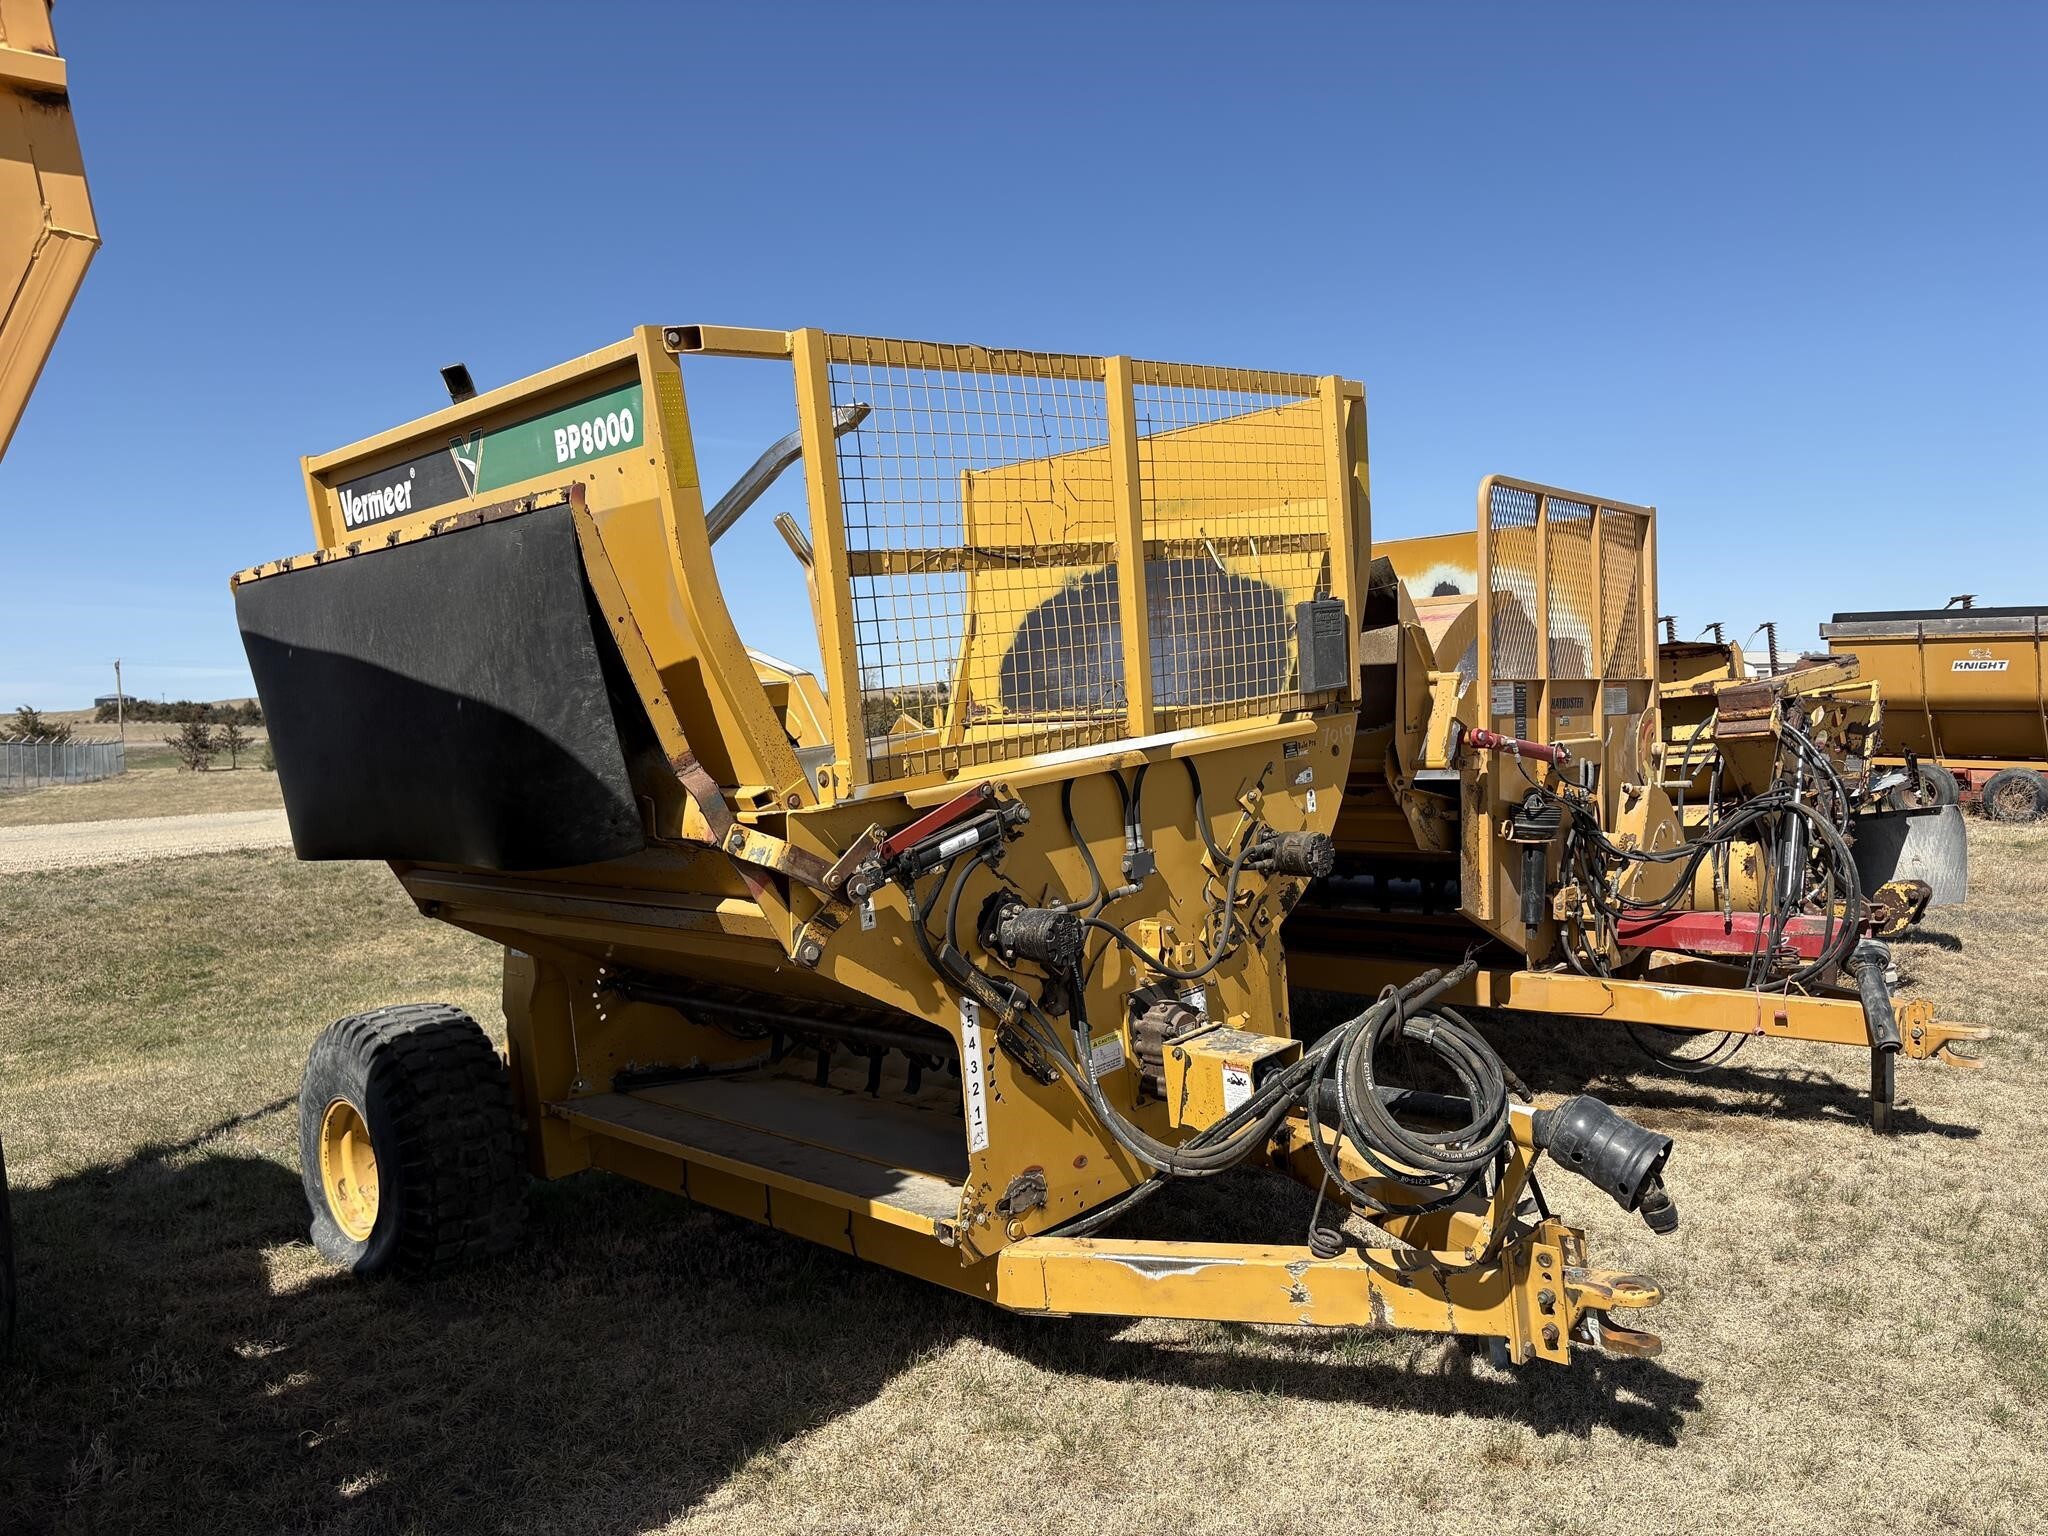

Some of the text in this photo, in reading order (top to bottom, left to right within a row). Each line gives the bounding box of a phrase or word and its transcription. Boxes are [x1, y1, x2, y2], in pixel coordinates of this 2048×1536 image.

[554, 408, 634, 463] BP8000
[1551, 697, 1584, 709] HAYBUSTER
[967, 1015, 974, 1028] 5
[969, 1036, 976, 1050] 4
[1098, 1034, 1119, 1045] CAUTION
[971, 1061, 978, 1074] 3
[1363, 1062, 1374, 1091] EC215-08
[972, 1082, 980, 1096] 2
[975, 1105, 981, 1119] 1
[1401, 1175, 1431, 1185] EC215-08
